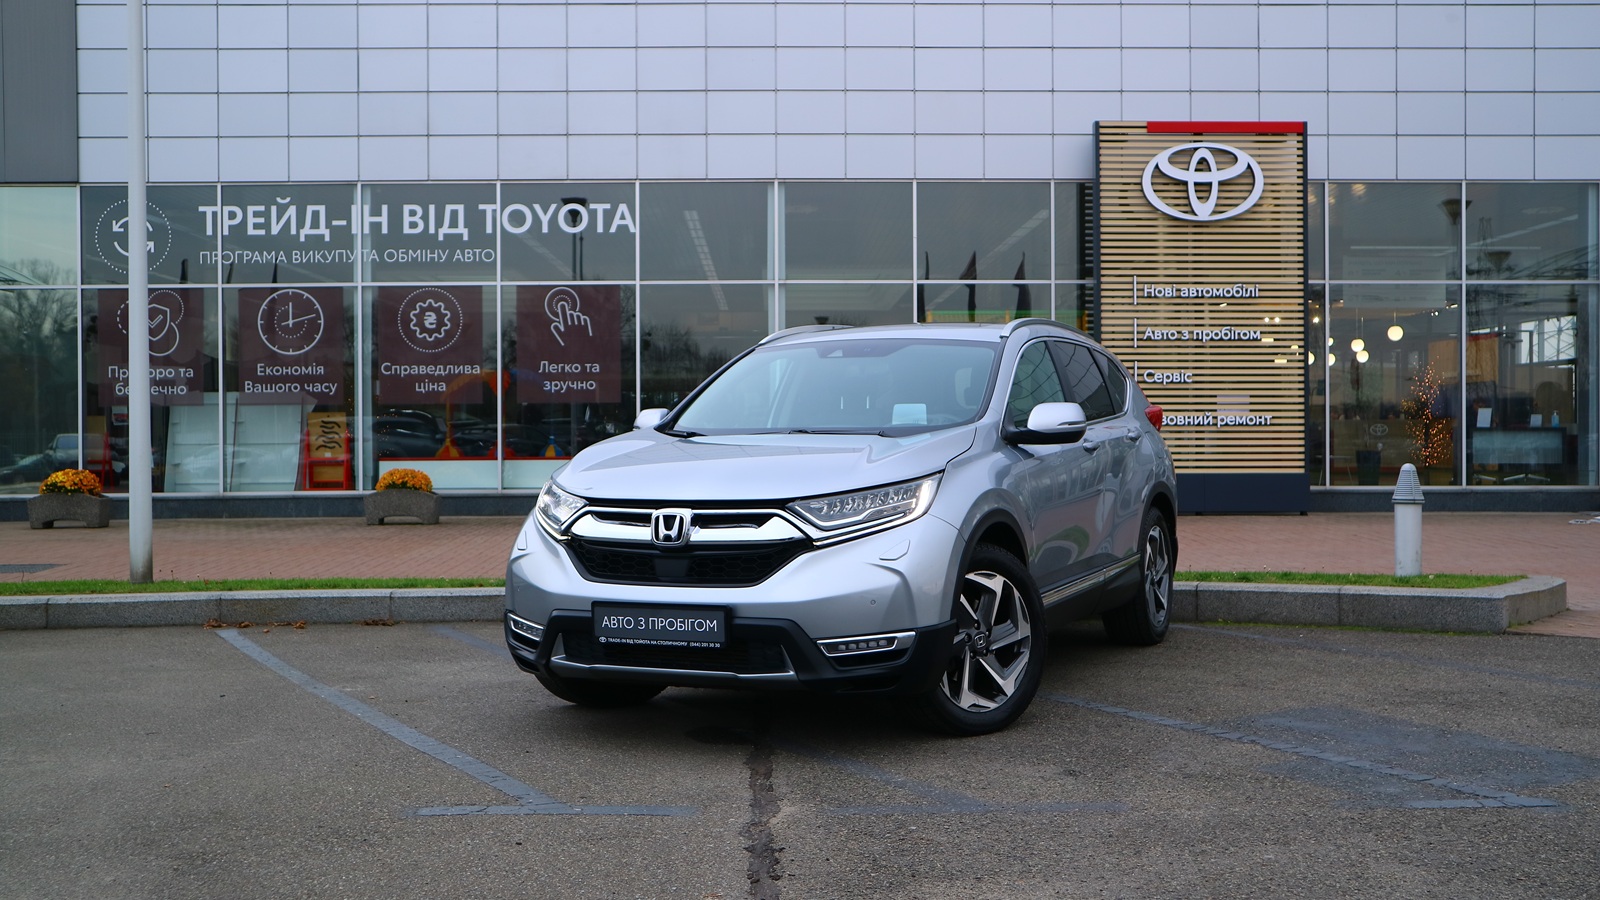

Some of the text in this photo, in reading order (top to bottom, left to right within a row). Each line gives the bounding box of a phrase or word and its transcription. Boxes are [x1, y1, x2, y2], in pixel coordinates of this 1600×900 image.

[199, 197, 637, 241] ТРЕЙД-ІН ВІД TOYOTA
[199, 247, 495, 264] ПРОГРАМА ВИКУПУ ТА ОБМІНУ АВТО
[1143, 283, 1259, 298] Нові автомобілі
[1143, 326, 1261, 343] Авто з пробігом
[108, 365, 194, 381] Проро та
[256, 362, 325, 376] Економія
[381, 361, 480, 378] Справедлива
[538, 361, 600, 375] Легко та
[1143, 370, 1193, 385] Сервіс
[115, 382, 187, 396] беечно
[244, 380, 338, 396] Вашого часу
[415, 378, 447, 395] ціна
[543, 378, 596, 394] зручно
[1161, 411, 1273, 429] зовний ремонт
[602, 616, 634, 628] АВТО
[649, 617, 717, 631] ПРОБІГОМ
